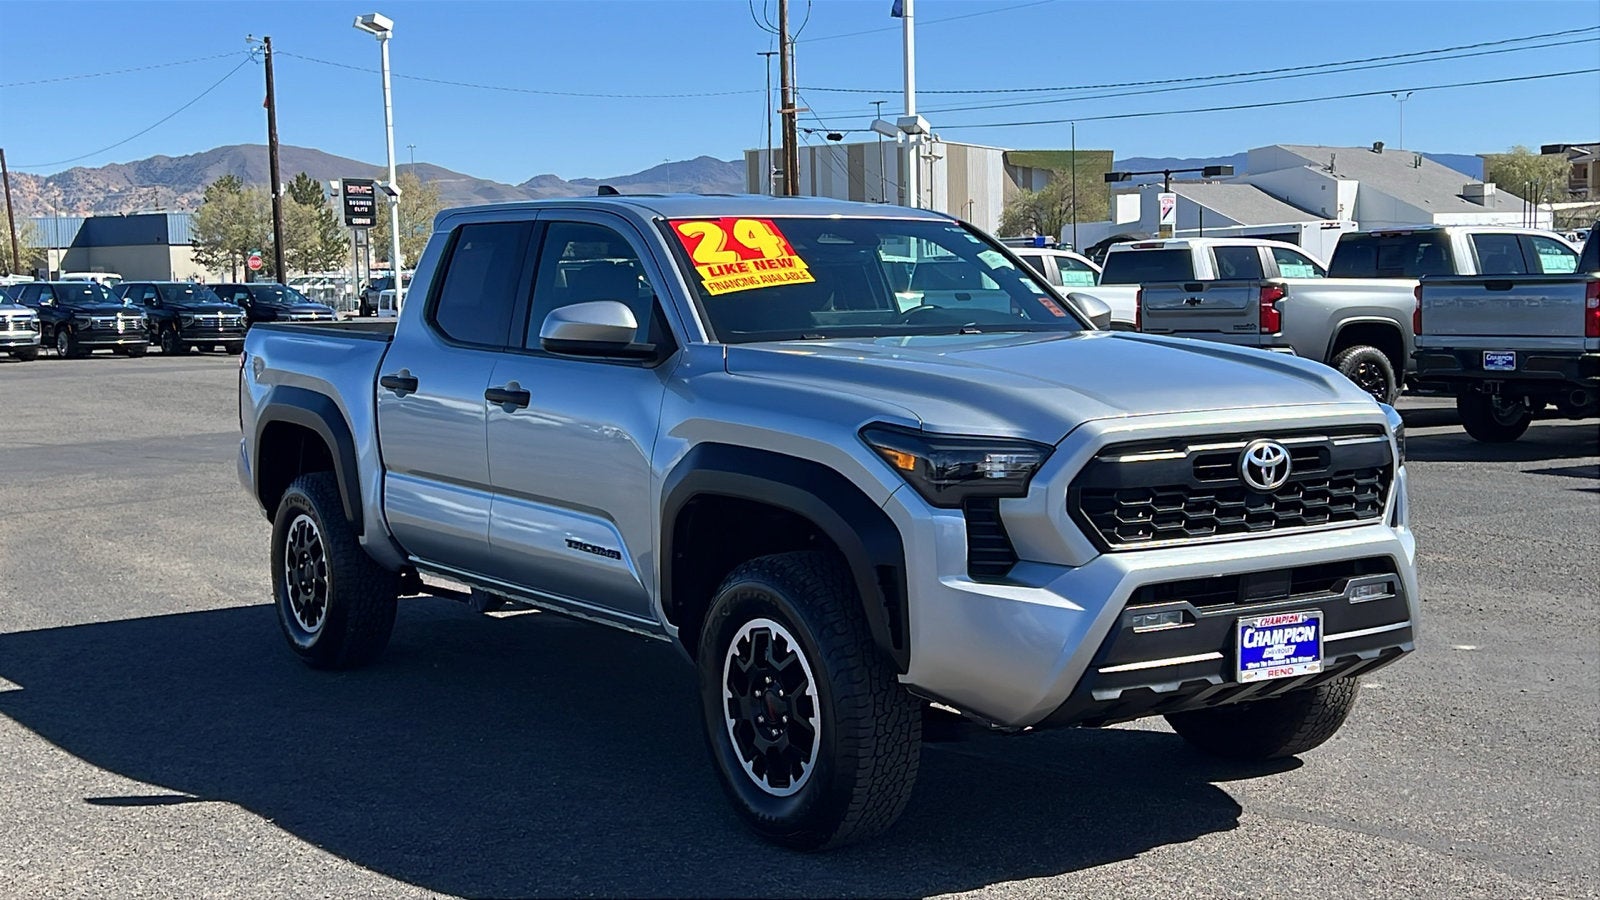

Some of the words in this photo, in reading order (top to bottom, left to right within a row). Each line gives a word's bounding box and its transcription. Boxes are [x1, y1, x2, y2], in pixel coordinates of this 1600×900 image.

[347, 185, 372, 194] GMC
[678, 219, 788, 264] 24
[708, 262, 749, 277] LIKE
[754, 258, 794, 270] NEW
[708, 275, 760, 293] FINANCING
[760, 270, 810, 285] AVAILABLE
[565, 538, 621, 560] TACOMA
[1260, 614, 1300, 626] CHAMPION
[1243, 626, 1316, 648] CHAMPION
[1268, 667, 1294, 677] RENO
